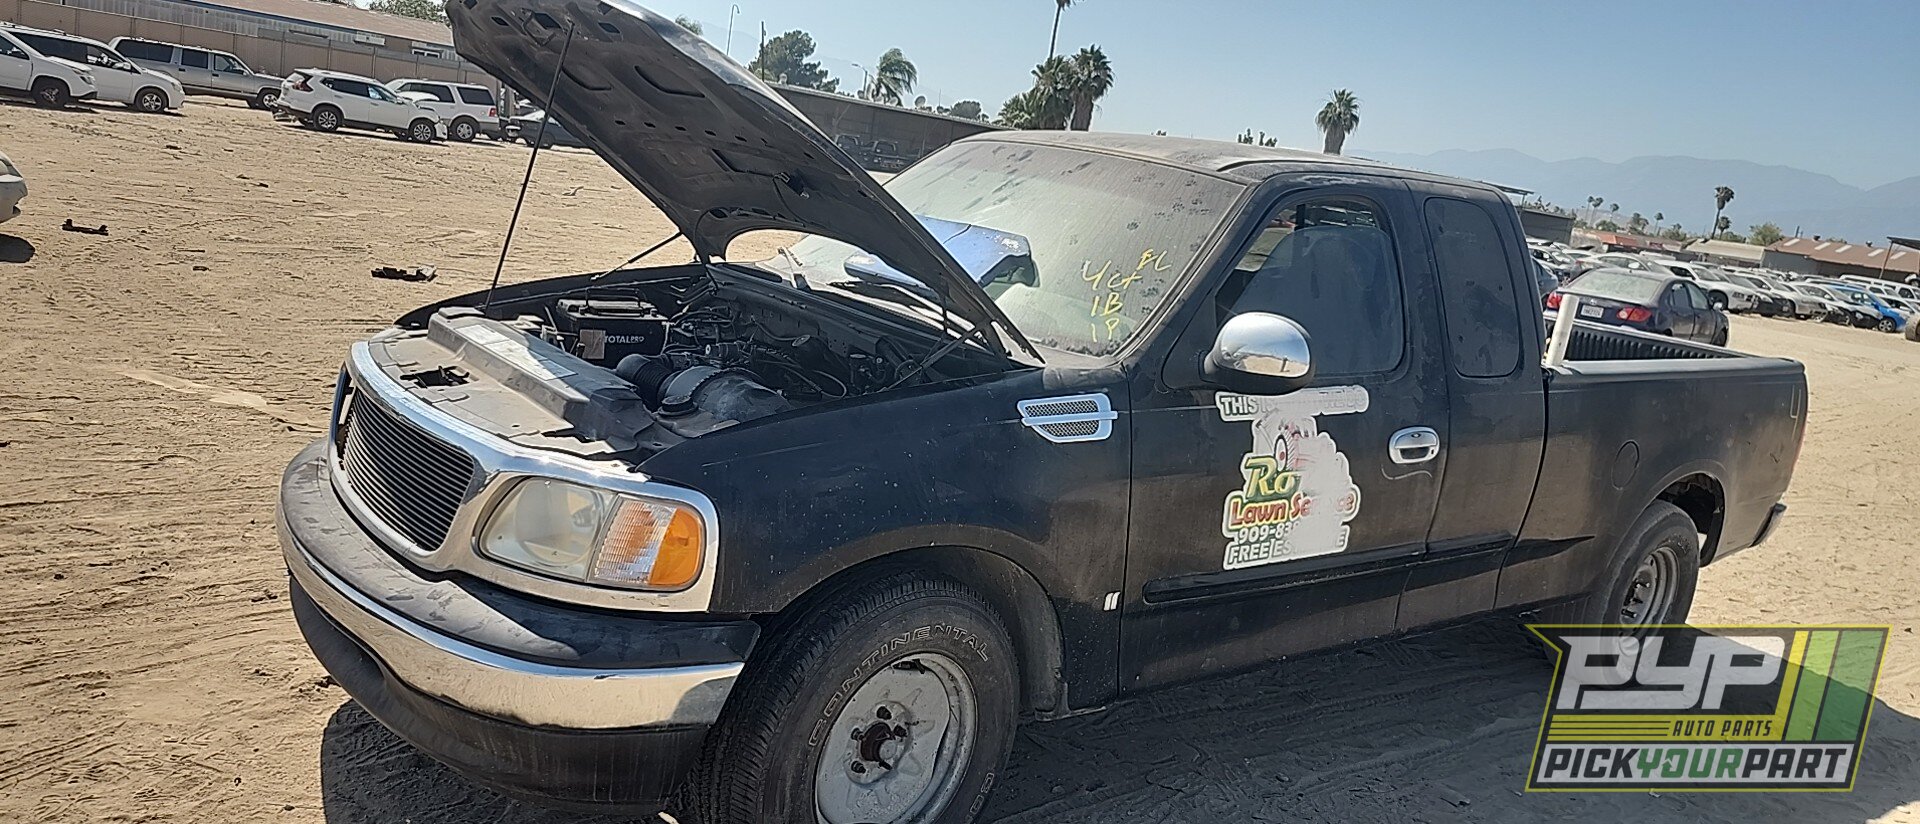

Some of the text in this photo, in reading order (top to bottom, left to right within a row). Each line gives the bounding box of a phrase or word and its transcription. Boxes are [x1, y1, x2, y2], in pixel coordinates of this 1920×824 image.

[1220, 396, 1257, 416] THIS
[1231, 499, 1288, 526] Lawn
[1228, 541, 1269, 565] FREE
[808, 625, 989, 746] CONTINENTAL
